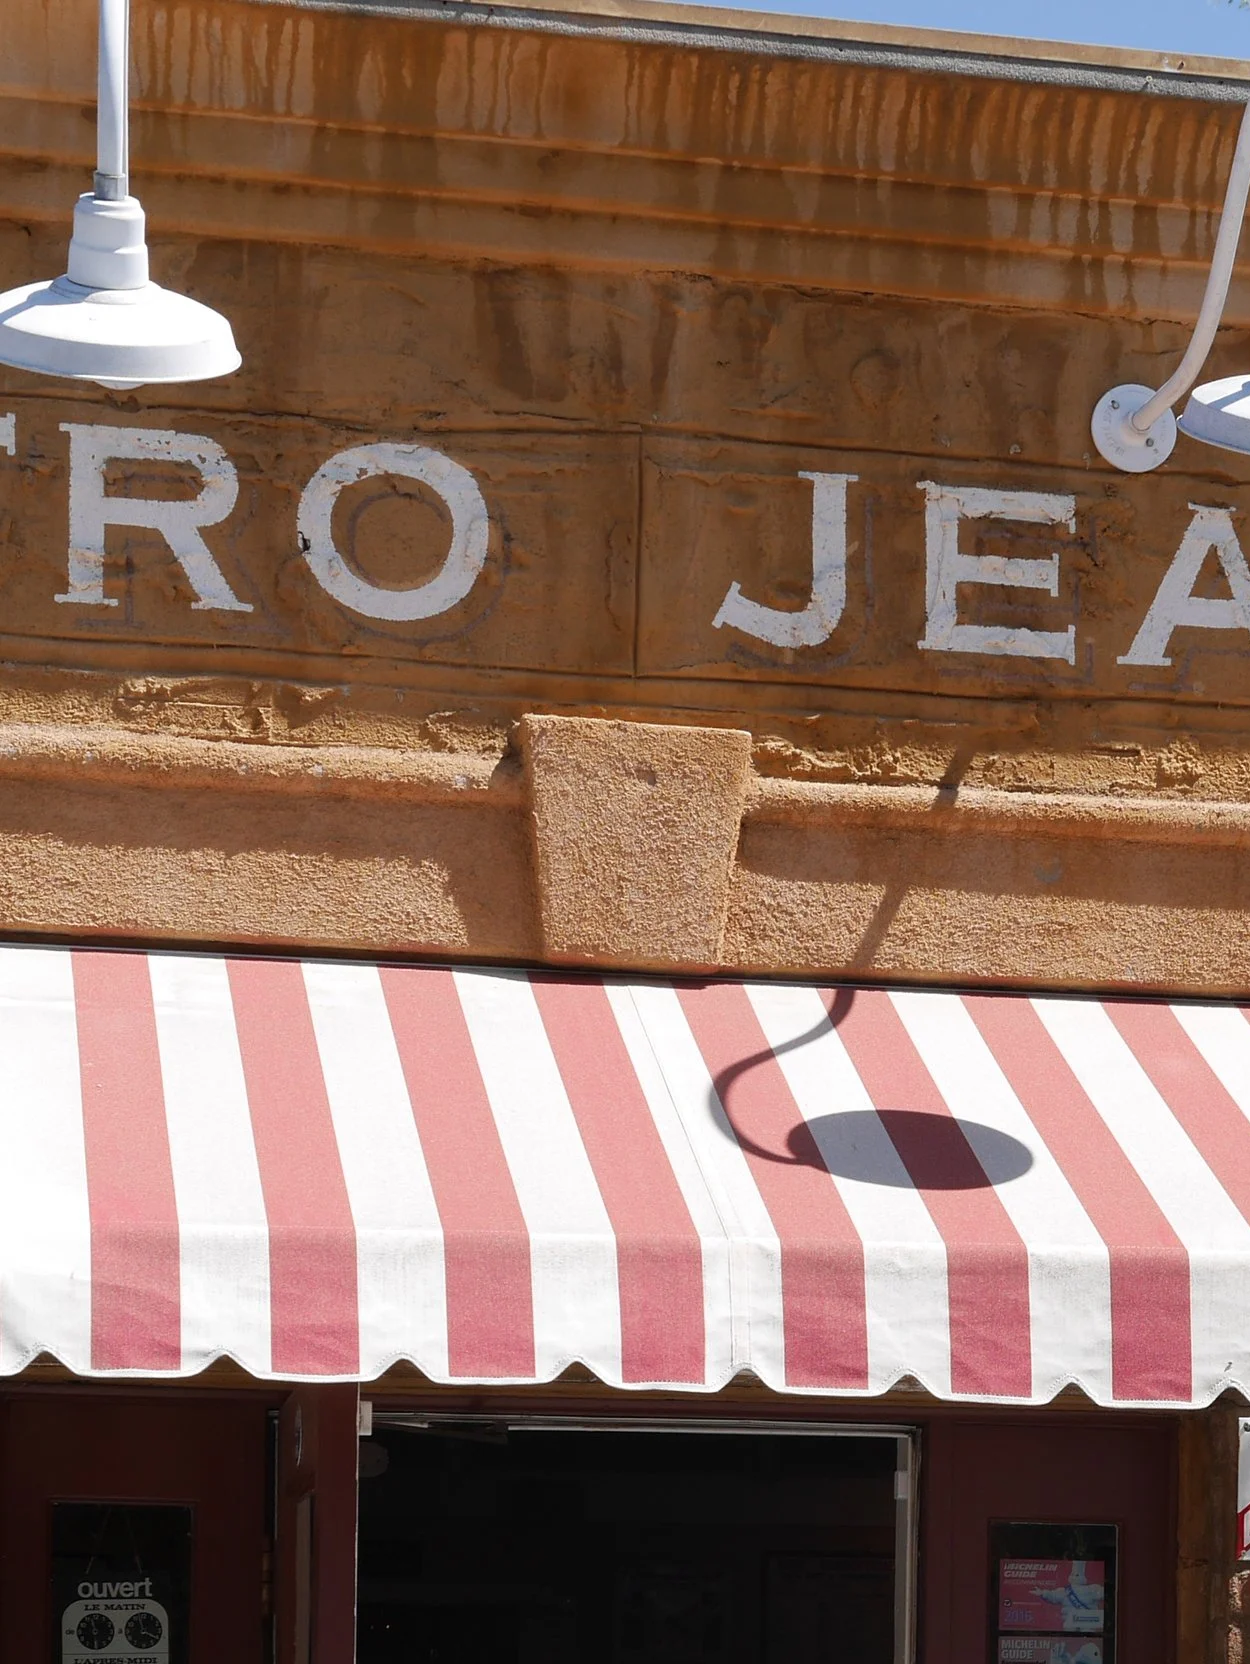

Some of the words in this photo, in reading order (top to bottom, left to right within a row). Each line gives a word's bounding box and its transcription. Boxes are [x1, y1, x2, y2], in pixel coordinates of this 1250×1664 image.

[0, 413, 490, 621] RO
[77, 1577, 153, 1598] ouvert
[104, 1603, 146, 1611] MATIN
[1001, 1639, 1051, 1649] MICHELIN
[1001, 1649, 1034, 1659] GUIDE
